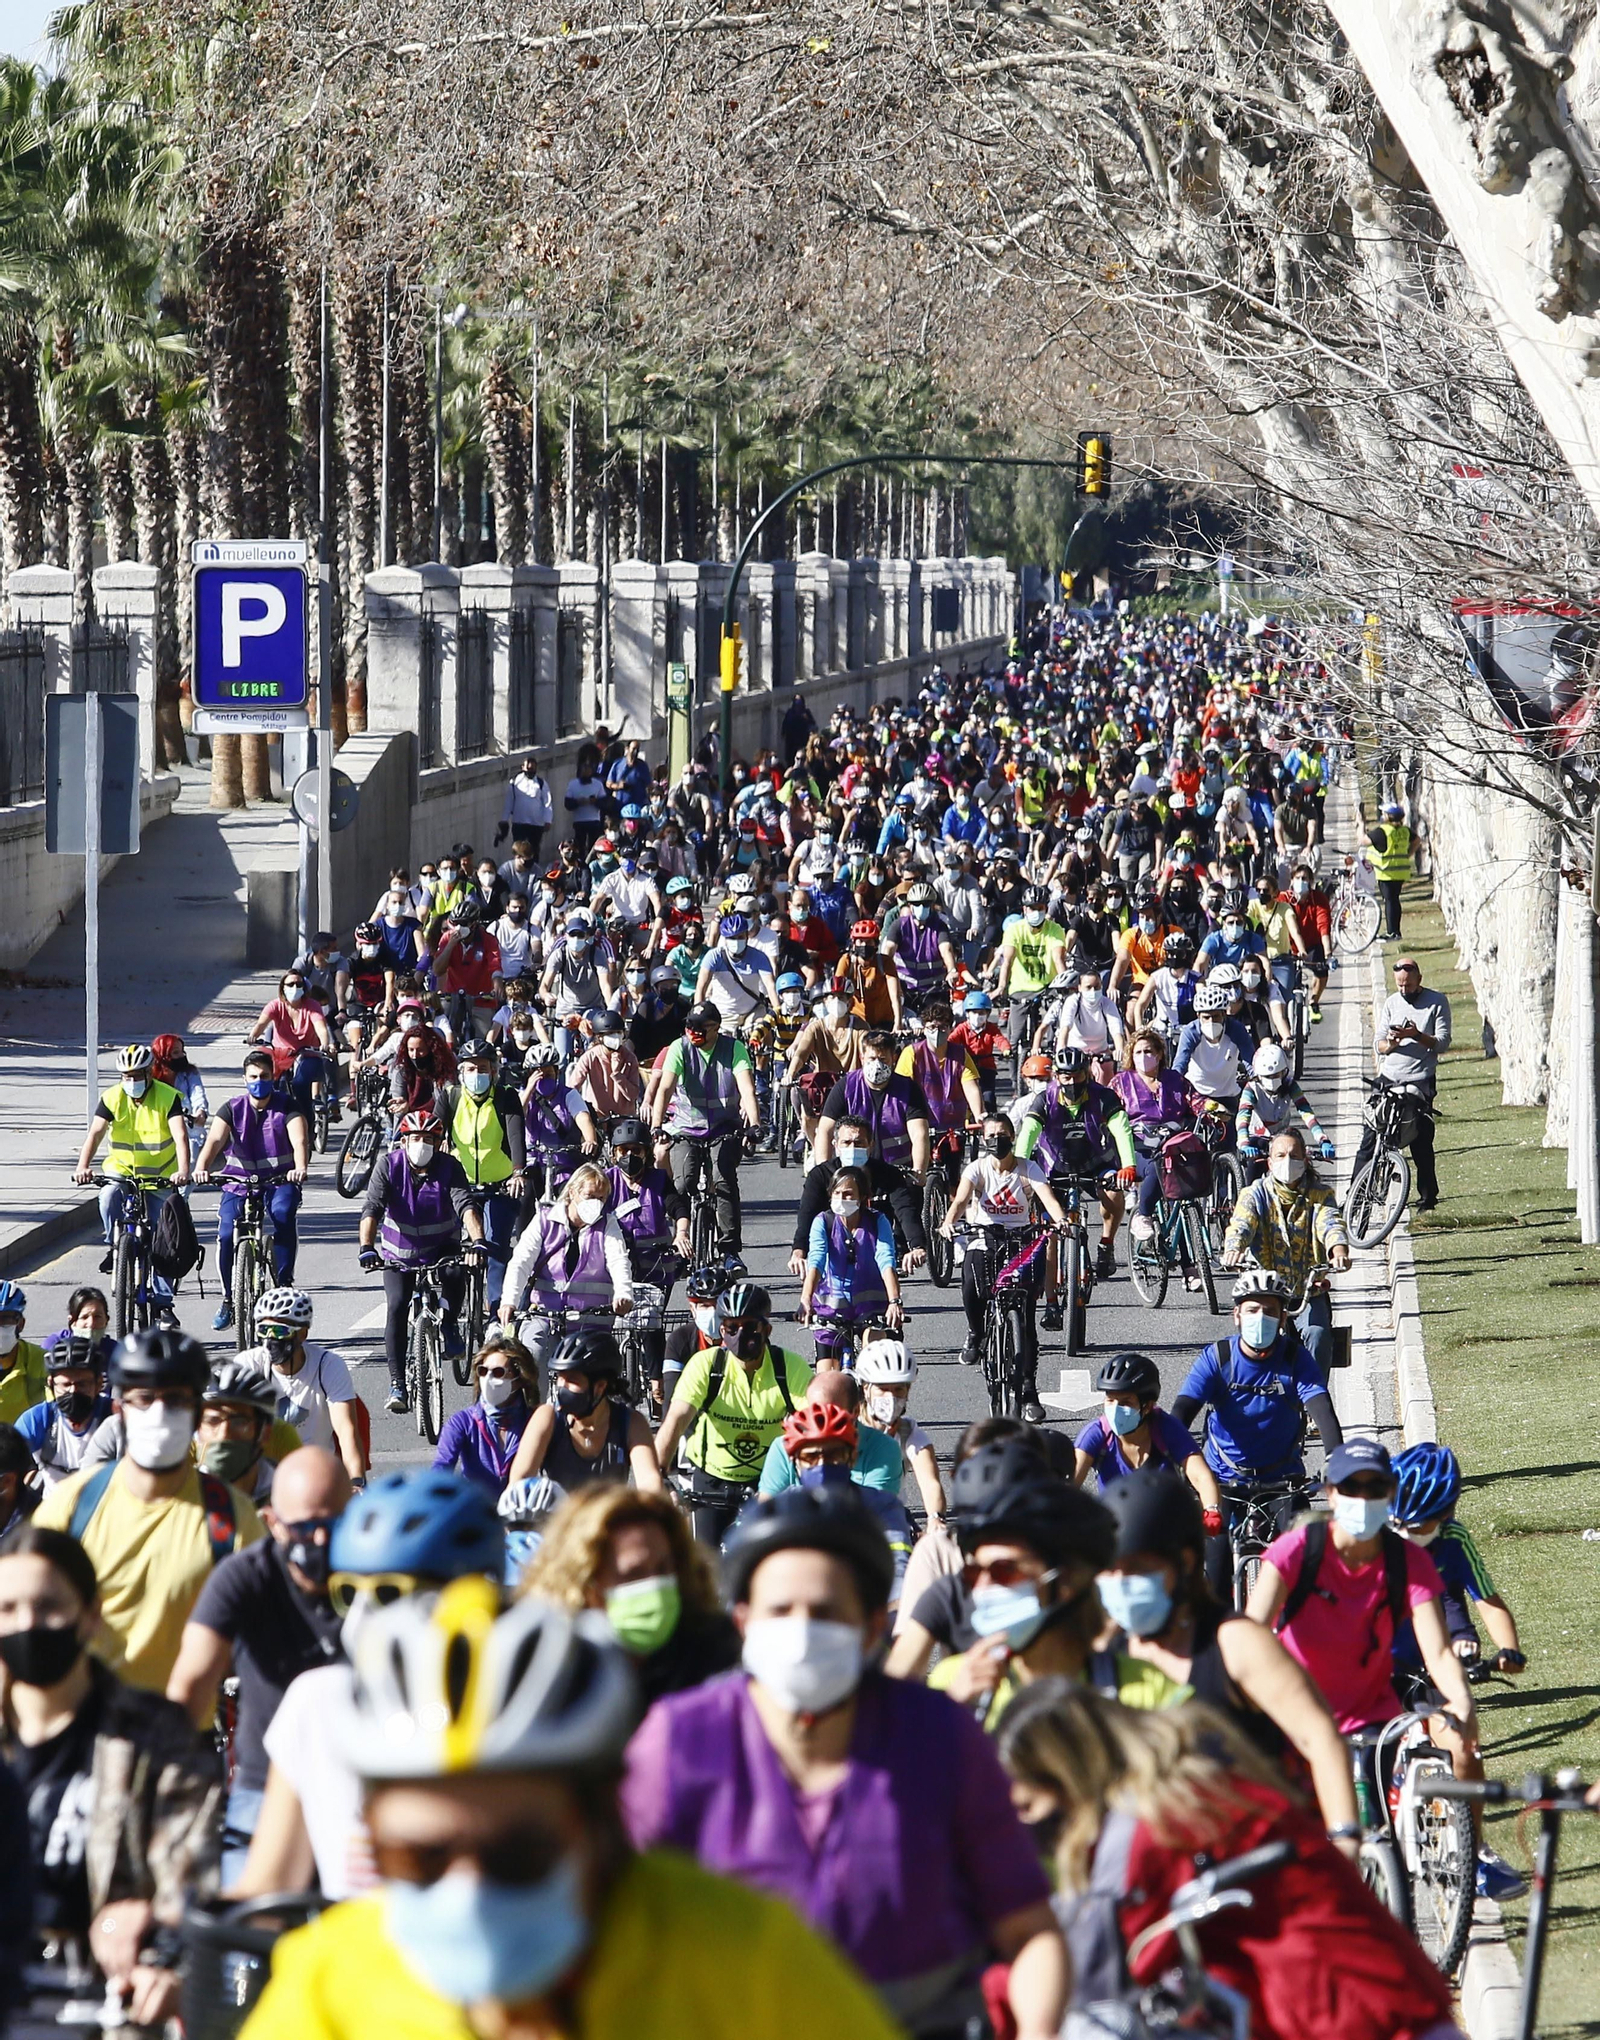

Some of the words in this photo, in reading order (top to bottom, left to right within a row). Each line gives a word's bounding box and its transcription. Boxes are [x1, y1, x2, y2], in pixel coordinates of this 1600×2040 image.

[222, 547, 296, 560] muelleuno
[222, 582, 287, 668] P
[231, 683, 278, 697] LIBRE
[209, 712, 239, 721] Centre
[241, 711, 287, 723] Pompidou
